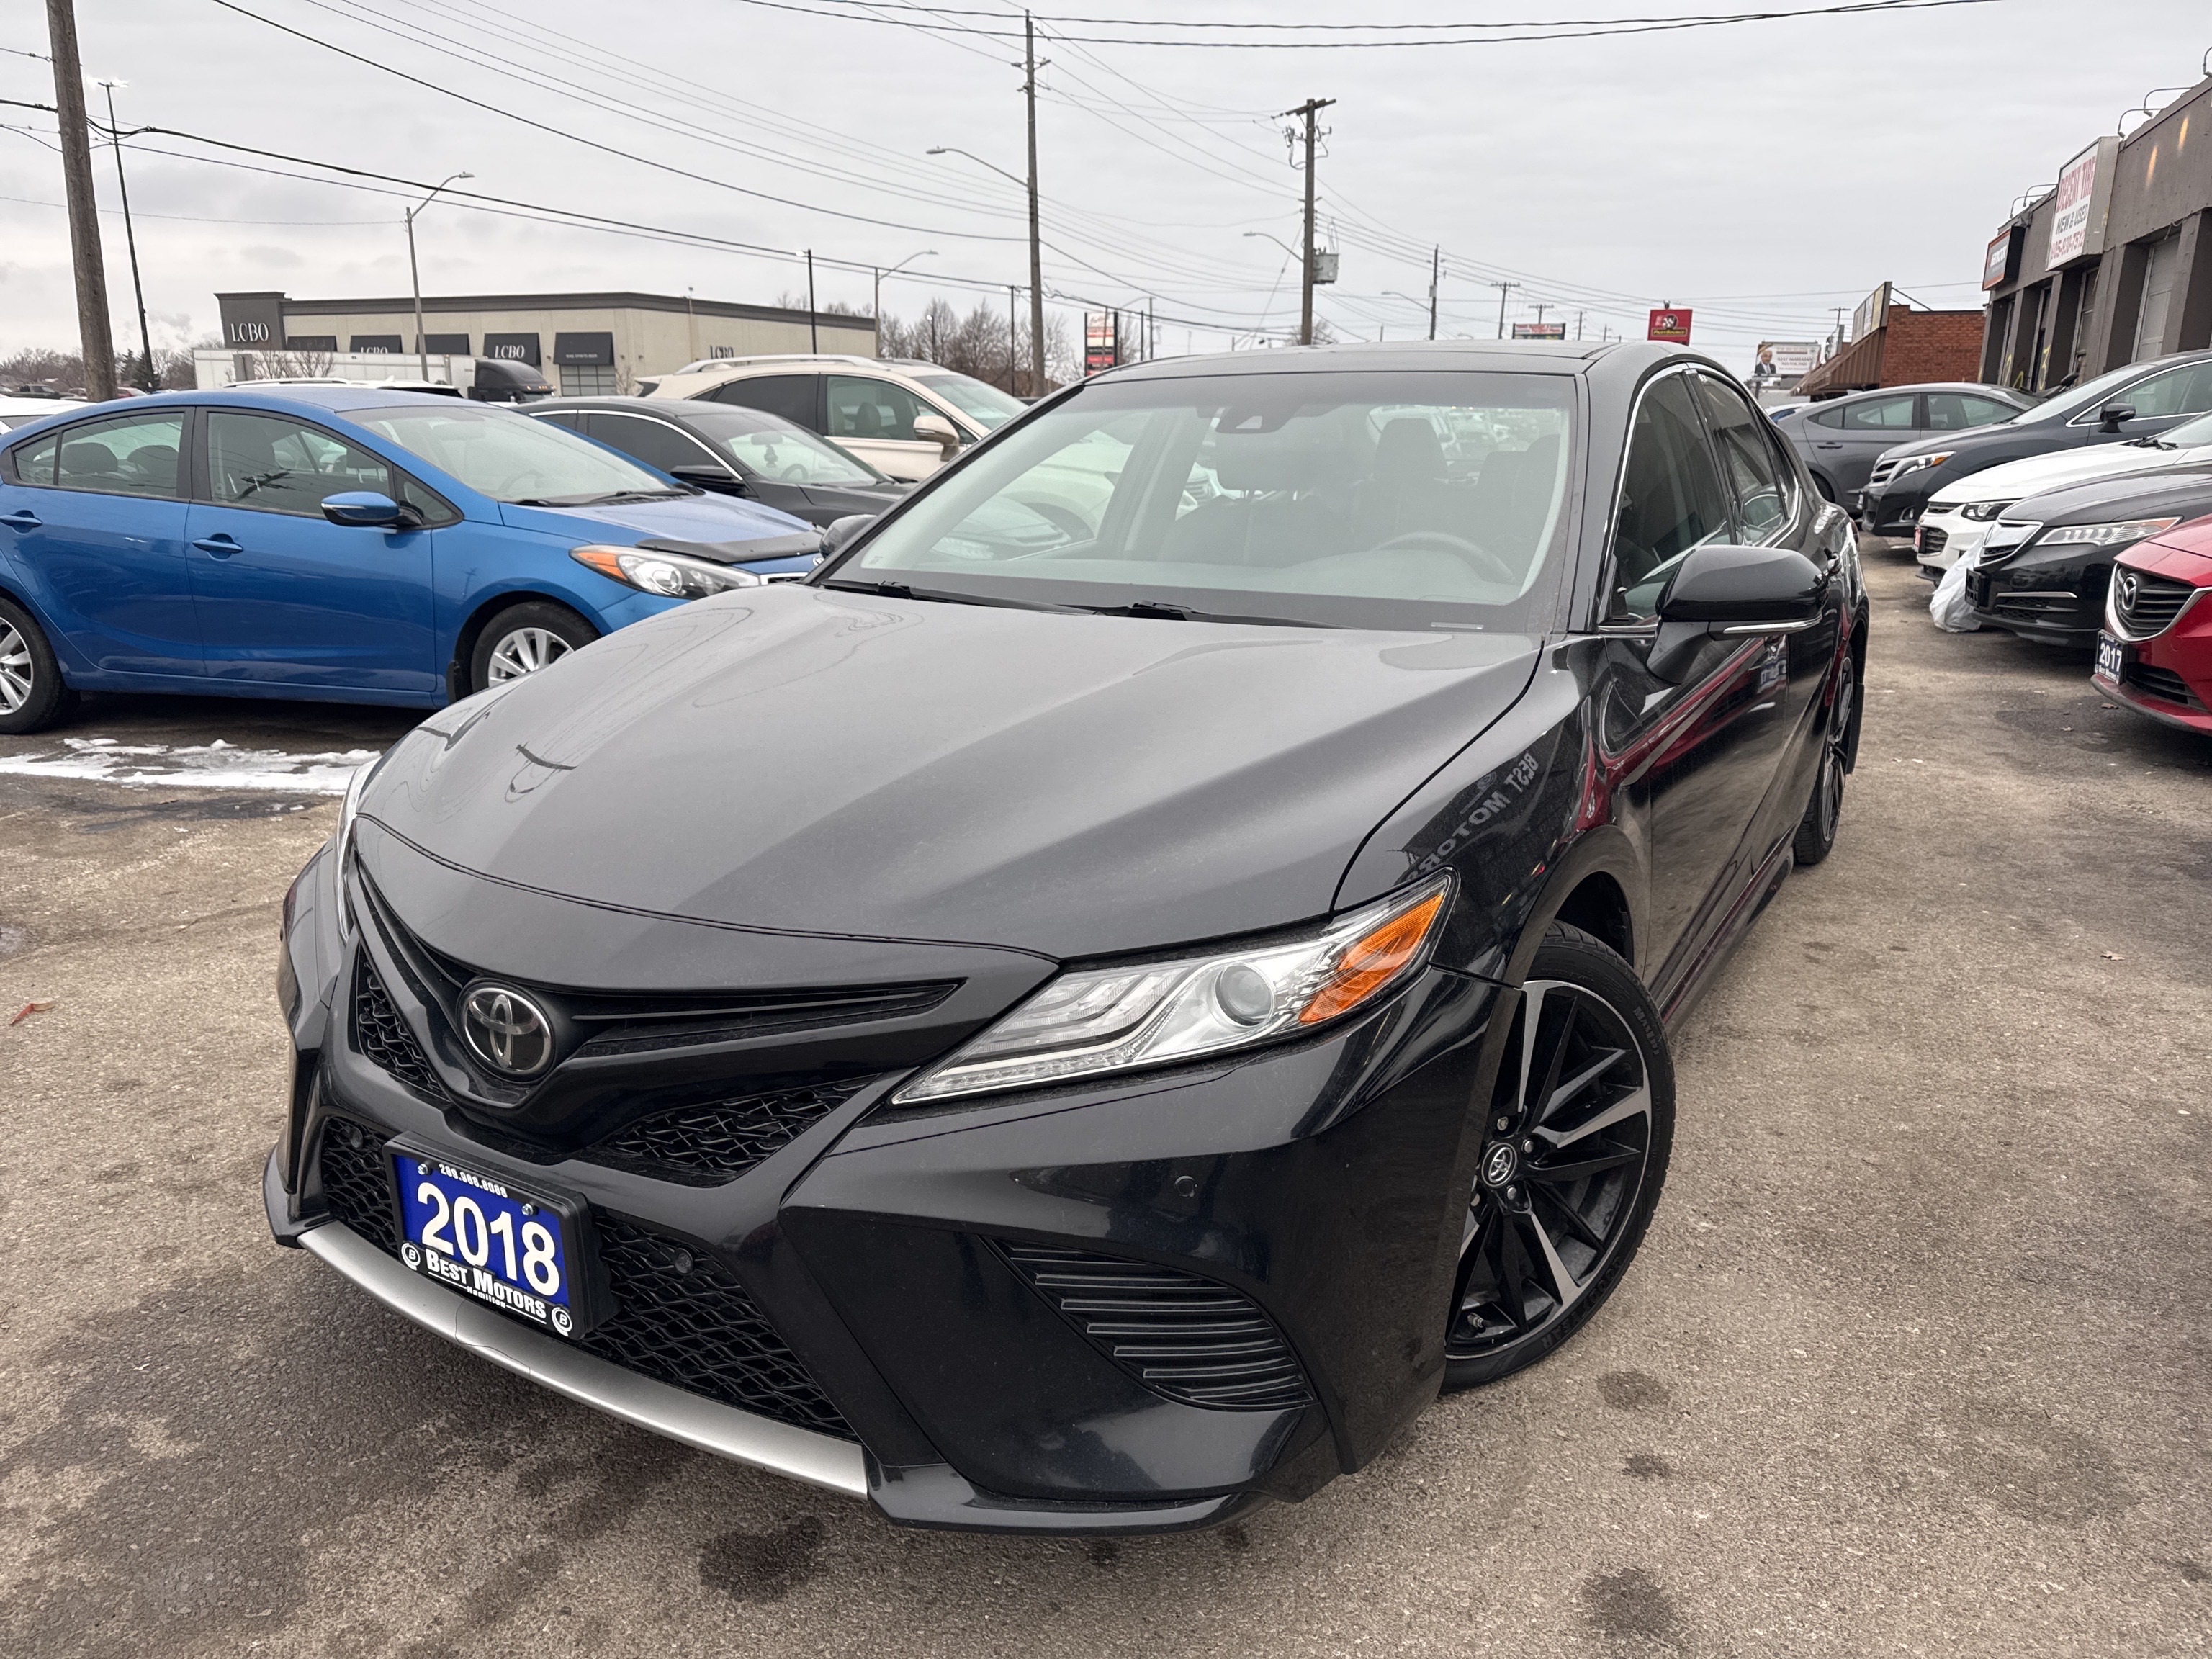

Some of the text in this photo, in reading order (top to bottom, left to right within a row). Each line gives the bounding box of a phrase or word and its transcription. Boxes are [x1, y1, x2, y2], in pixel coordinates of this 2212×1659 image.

[2056, 215, 2069, 235] NEW
[2073, 202, 2089, 228] USED
[230, 322, 269, 342] LCBO
[494, 344, 525, 359] LCBO
[2099, 642, 2122, 672] 2017
[439, 1163, 508, 1199] 289.988.8088
[417, 1182, 560, 1297] 2018
[425, 1248, 547, 1319] BEST MOTORS
[467, 1285, 506, 1309] Hamilton
